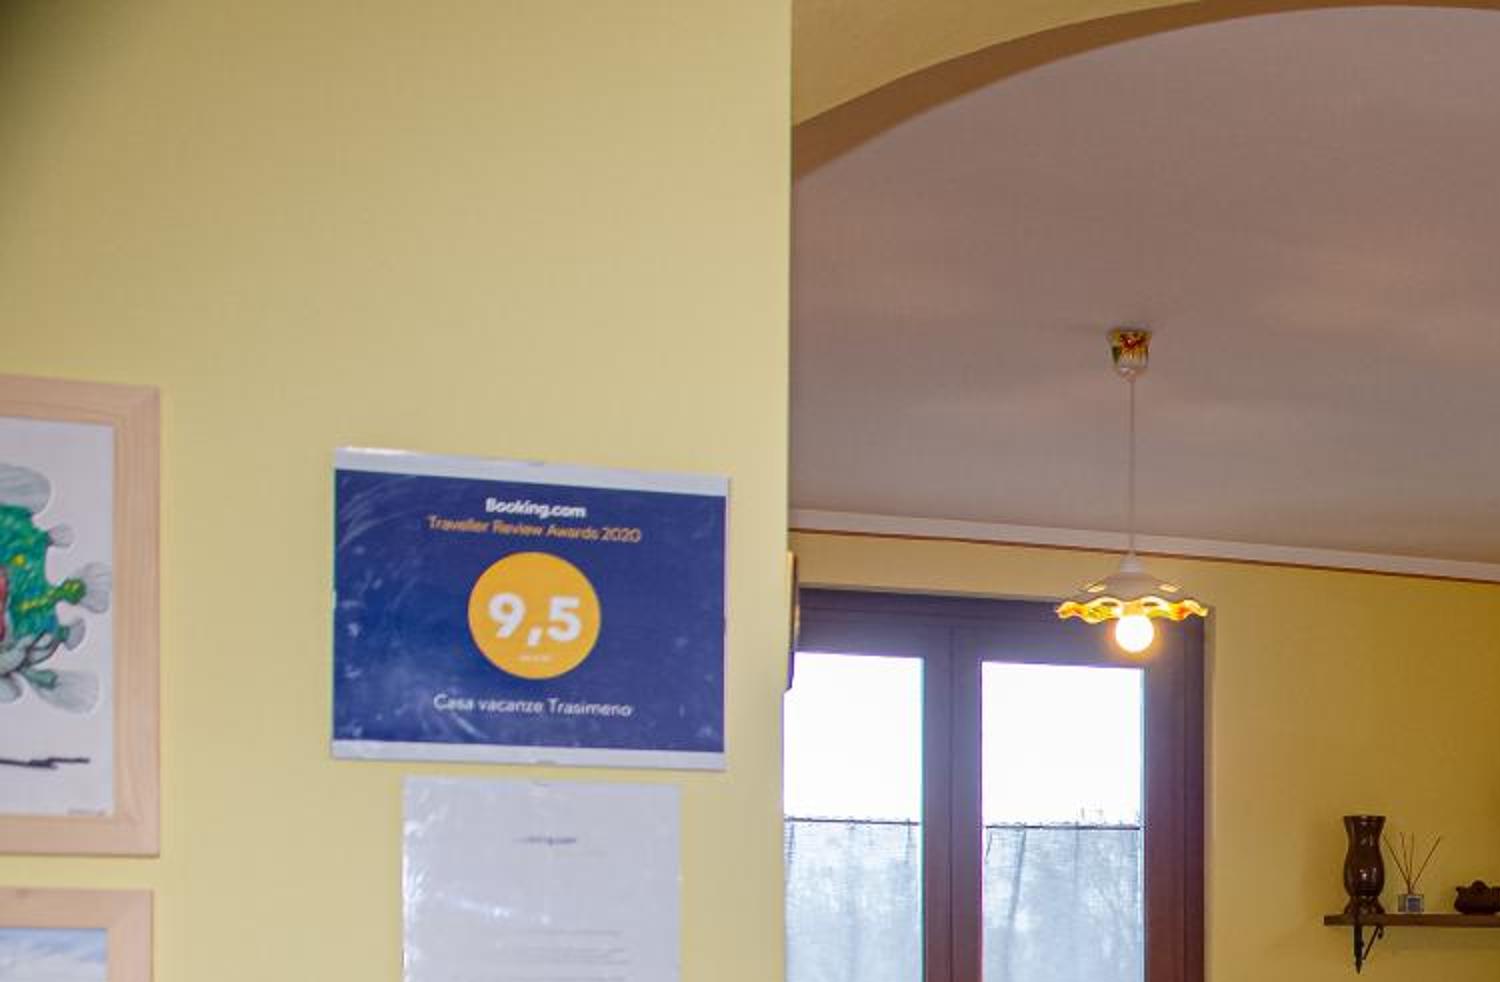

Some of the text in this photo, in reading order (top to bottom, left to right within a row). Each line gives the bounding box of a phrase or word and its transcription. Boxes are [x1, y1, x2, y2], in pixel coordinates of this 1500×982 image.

[485, 497, 586, 519] Booking.com
[493, 520, 543, 536] Review
[545, 524, 599, 540] Awards
[601, 527, 641, 543] 2020
[488, 592, 582, 647] 9,5
[433, 693, 634, 717] Casa vacanze Trasimeno
